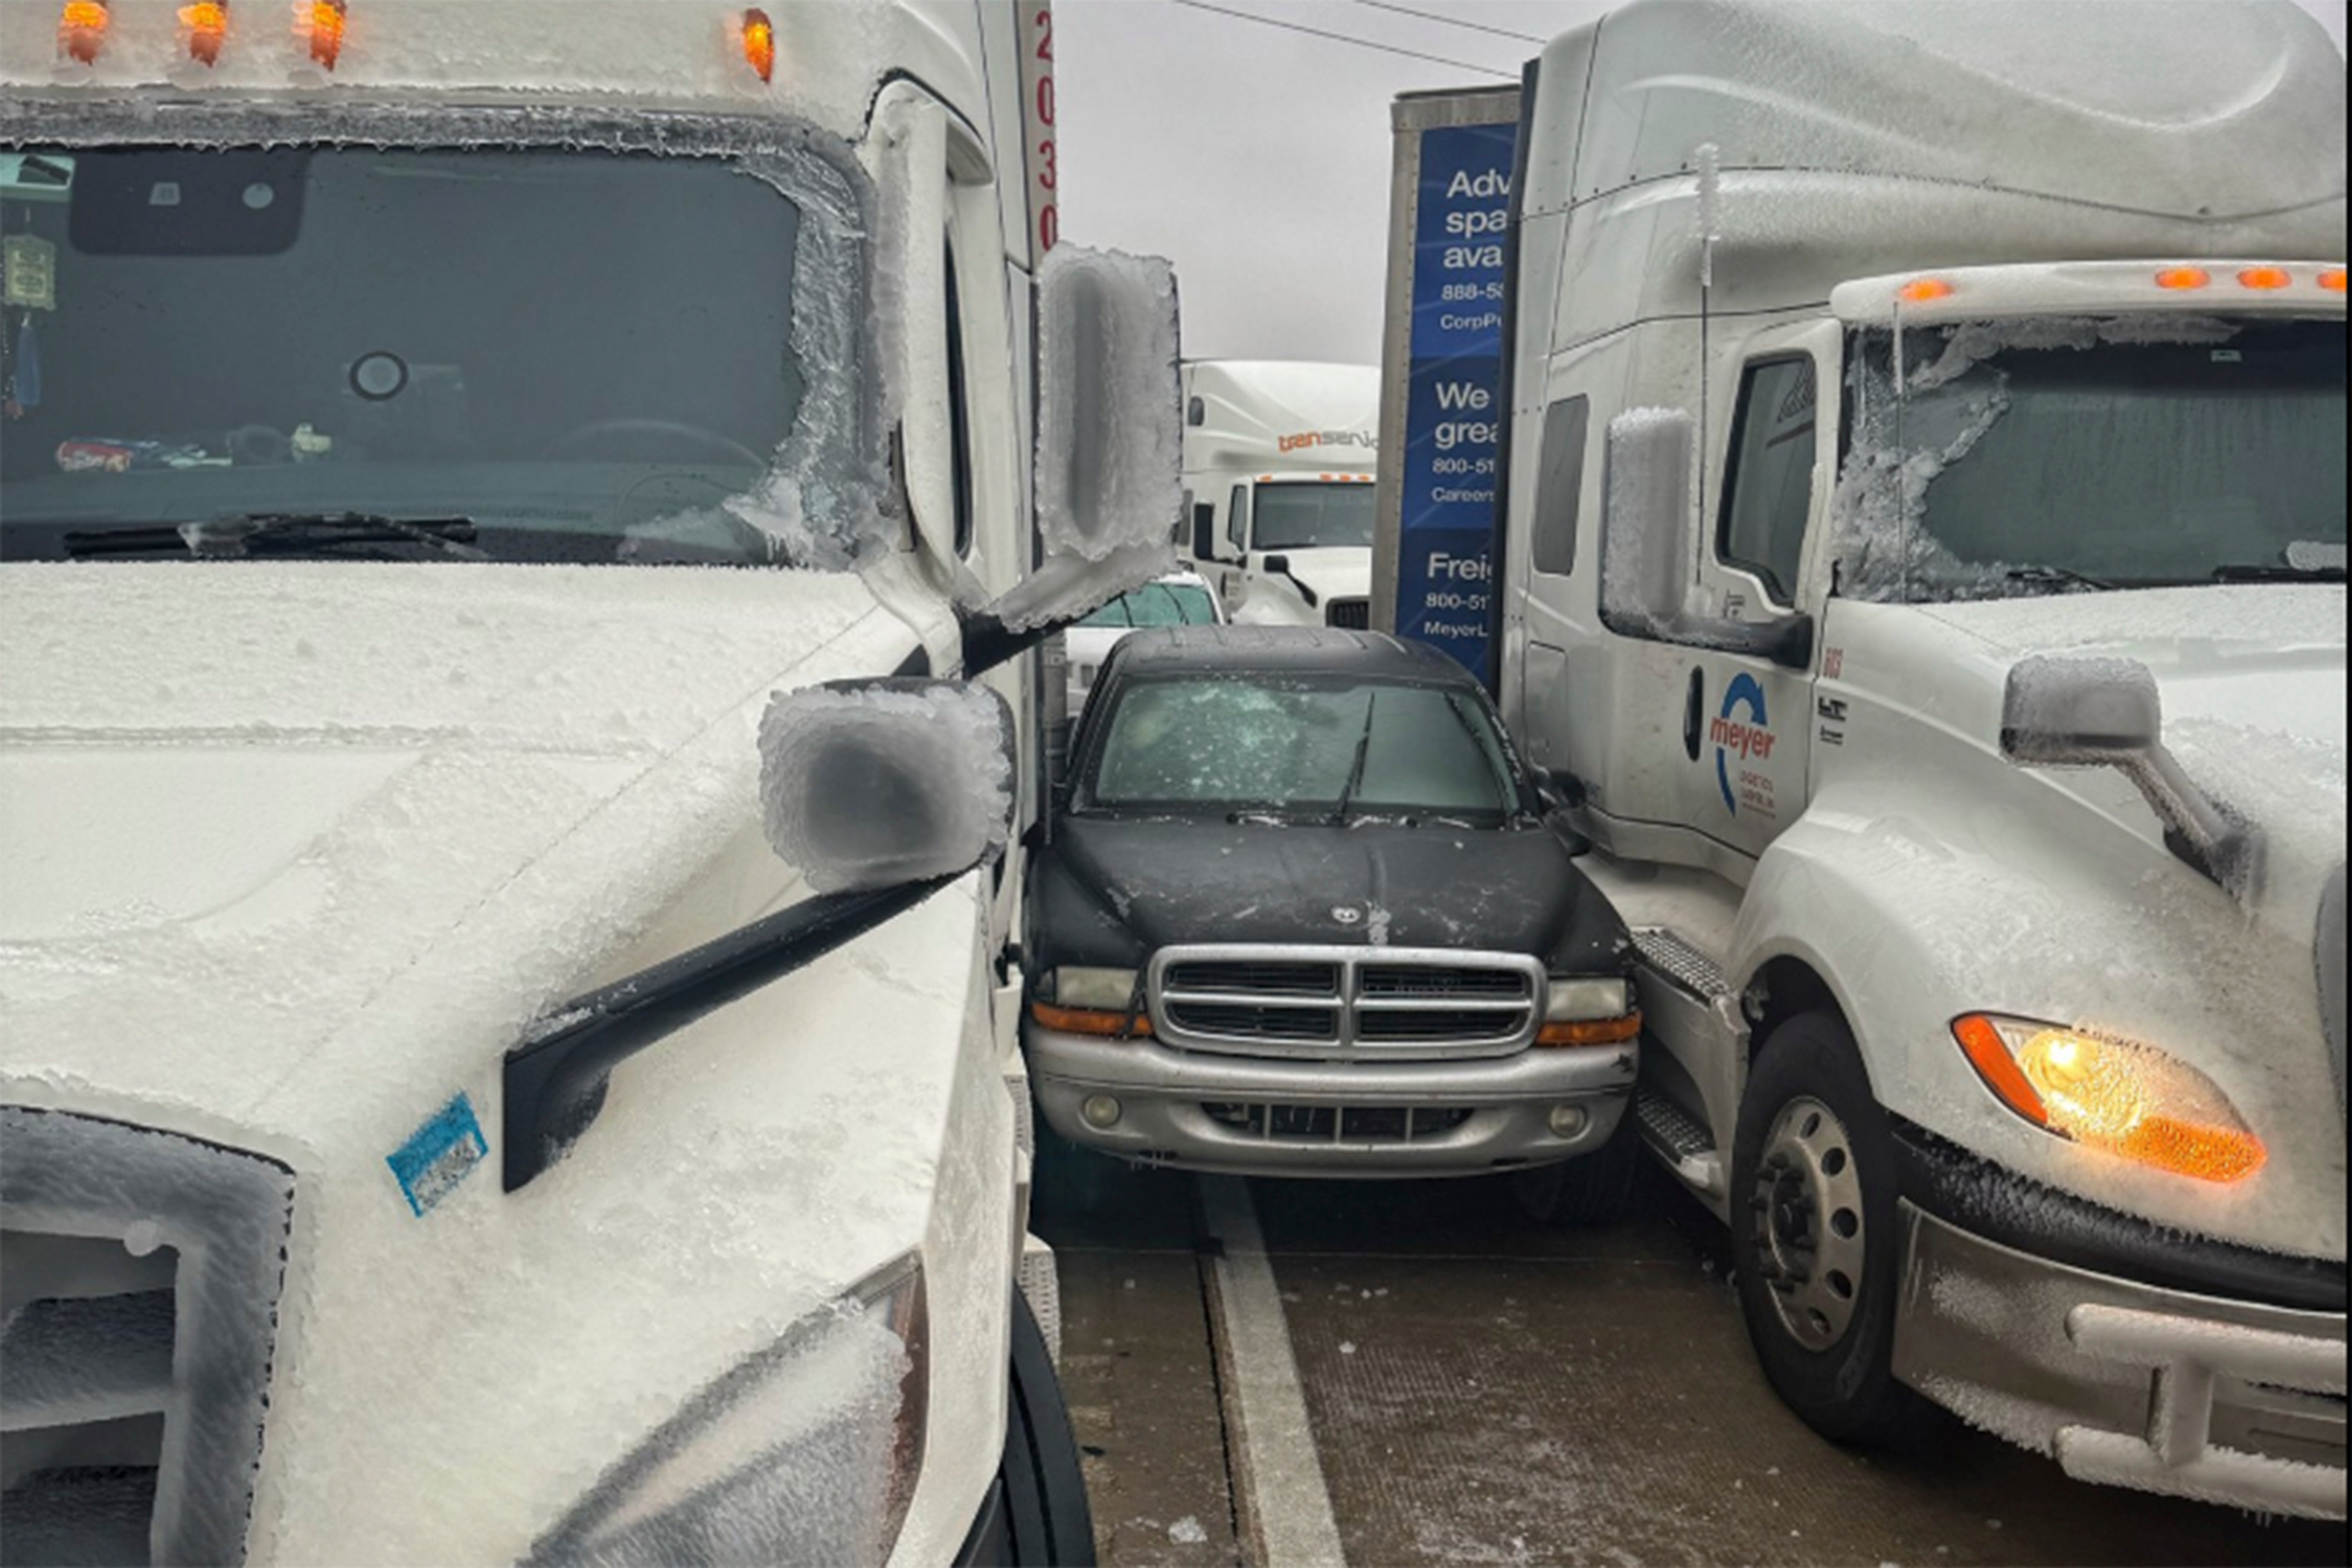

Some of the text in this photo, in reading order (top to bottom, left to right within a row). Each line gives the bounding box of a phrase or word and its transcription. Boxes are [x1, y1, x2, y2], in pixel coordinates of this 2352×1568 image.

[1036, 11, 1057, 252] 2030
[1446, 169, 1512, 198] Adv
[1446, 211, 1507, 238] spa
[1443, 245, 1502, 268] ava
[1435, 382, 1489, 410] We
[1428, 552, 1492, 583] Frei
[1426, 592, 1490, 610] 800-51
[1710, 716, 1776, 760] meyer
